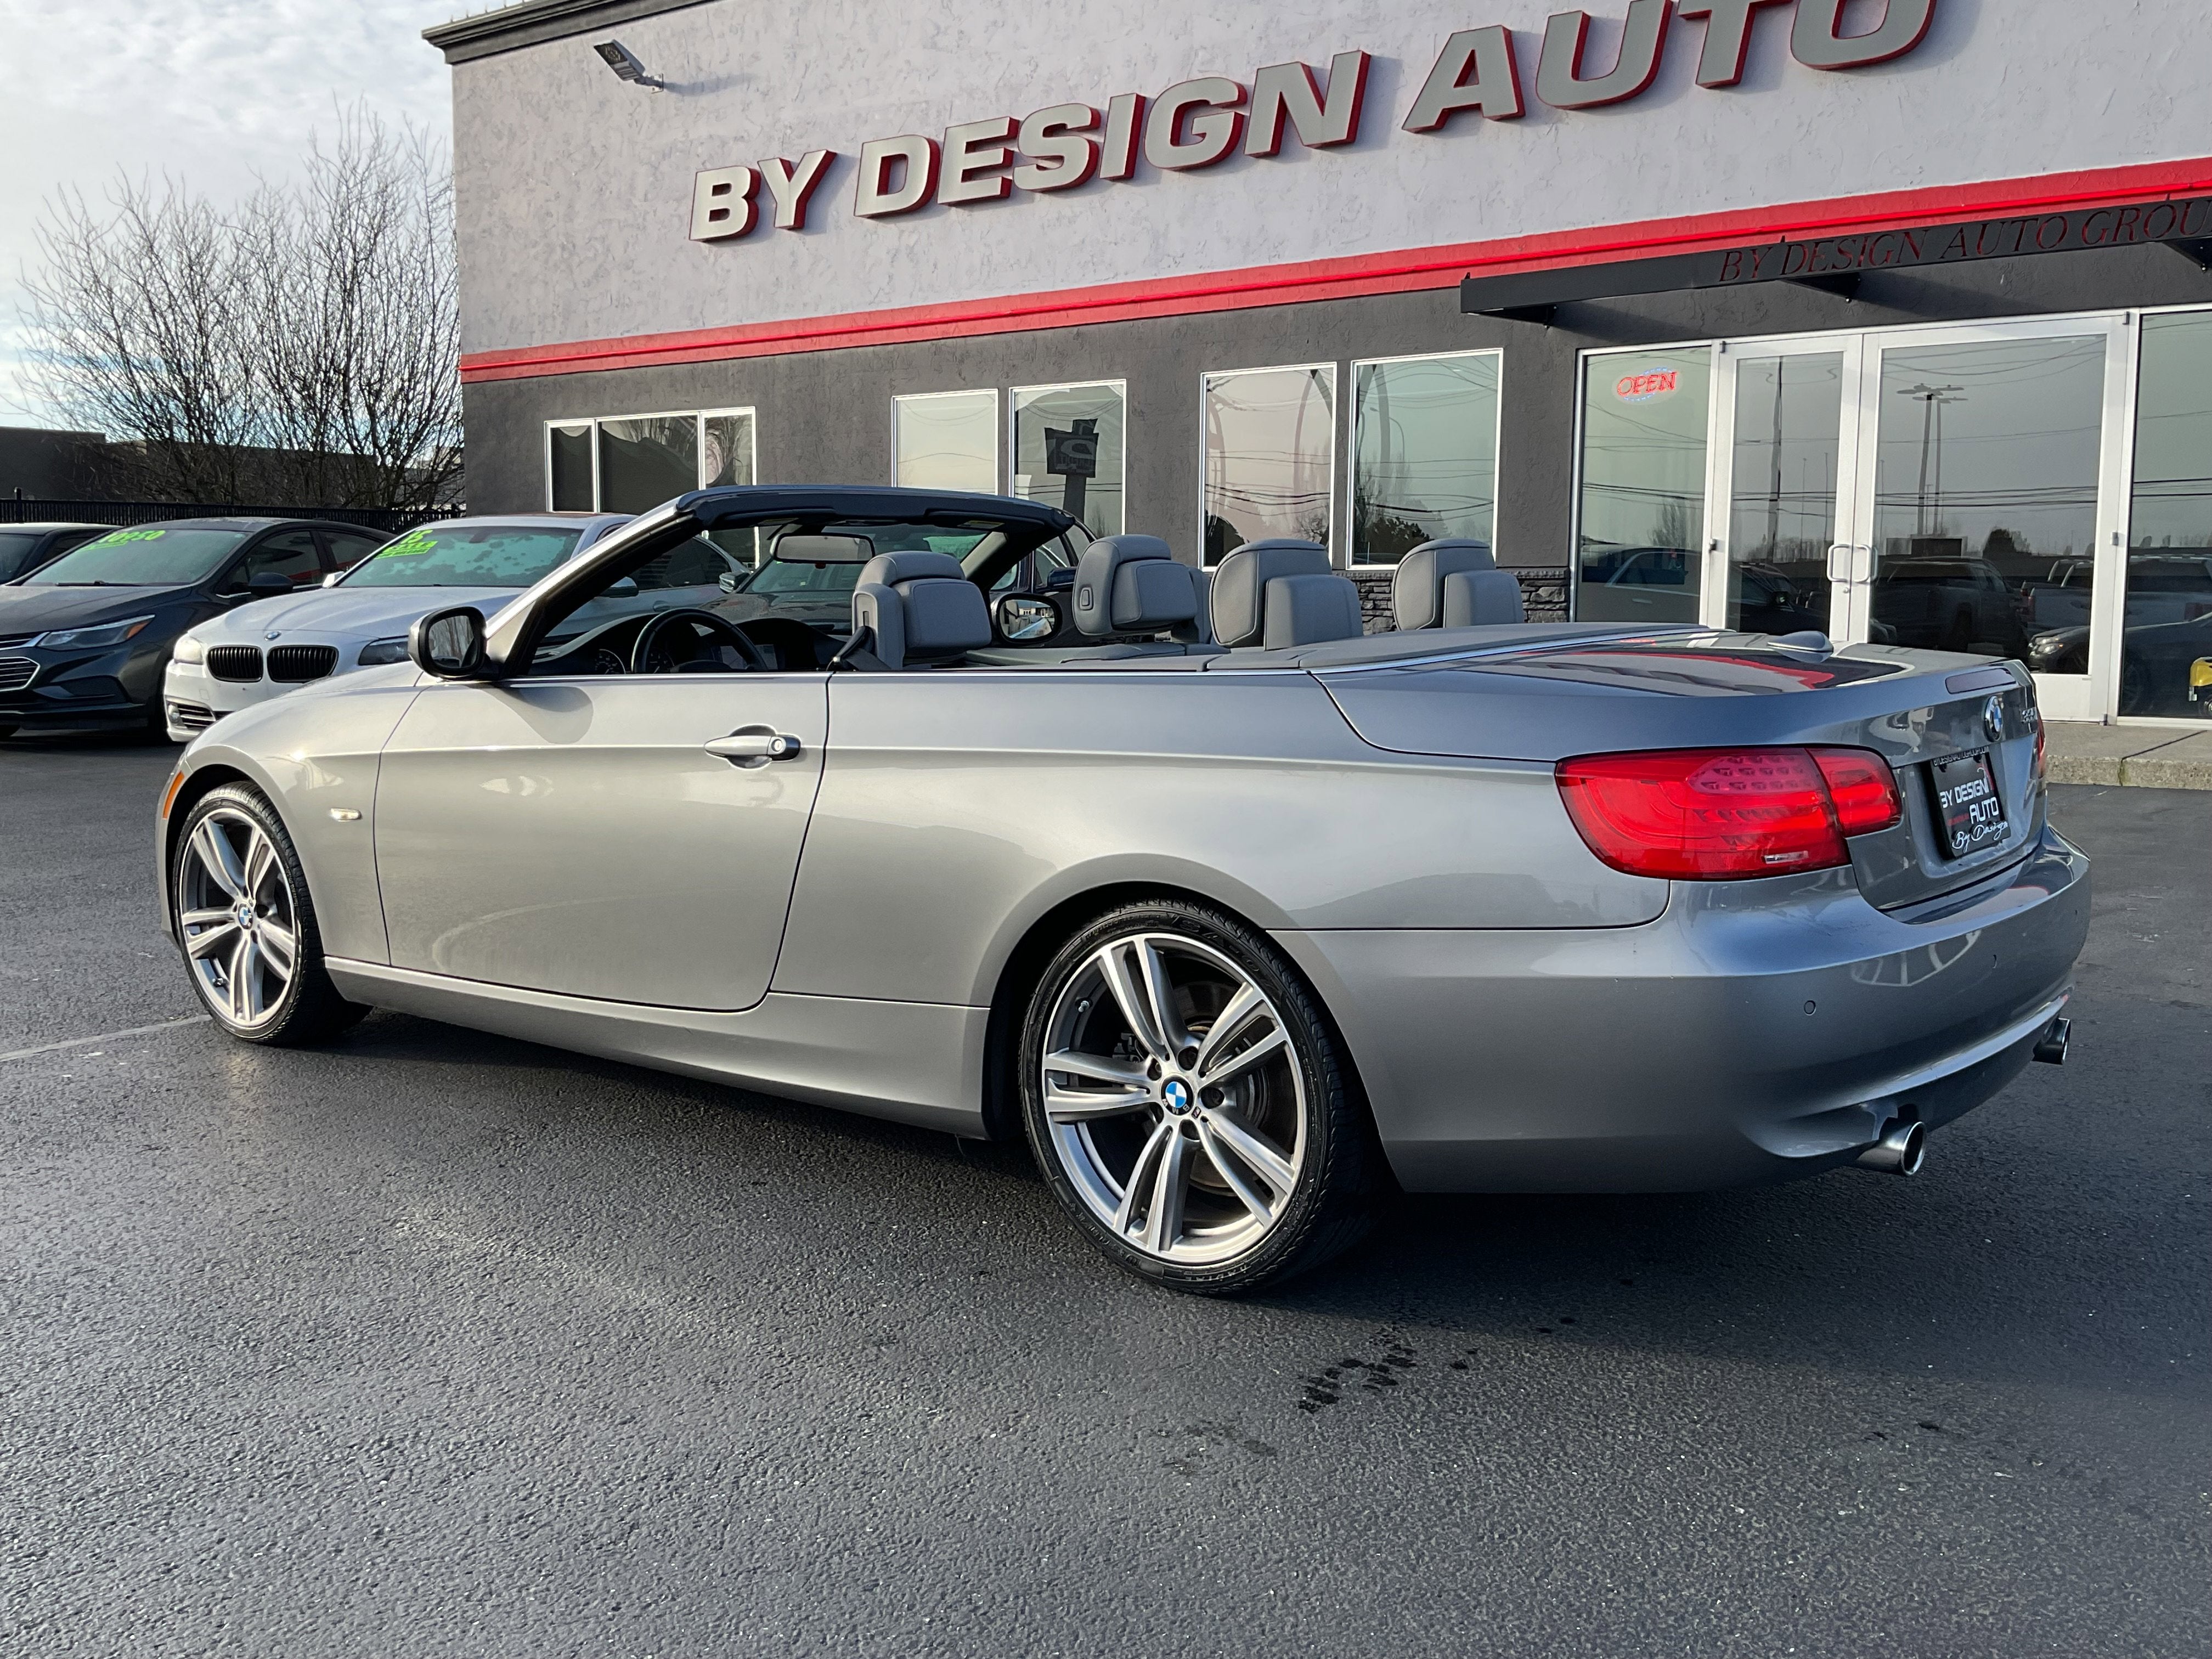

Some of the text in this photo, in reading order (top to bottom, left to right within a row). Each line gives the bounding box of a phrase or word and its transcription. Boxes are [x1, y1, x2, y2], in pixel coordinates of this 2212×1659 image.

[689, 0, 1938, 242] BY DESIGN AUTO
[1719, 199, 2212, 283] BY DESIGN AUTO GROU
[1617, 371, 1678, 397] OPEN
[1954, 777, 1989, 804] DESIGN
[1969, 797, 1999, 824] AUTO
[1951, 821, 2008, 853] By Design
